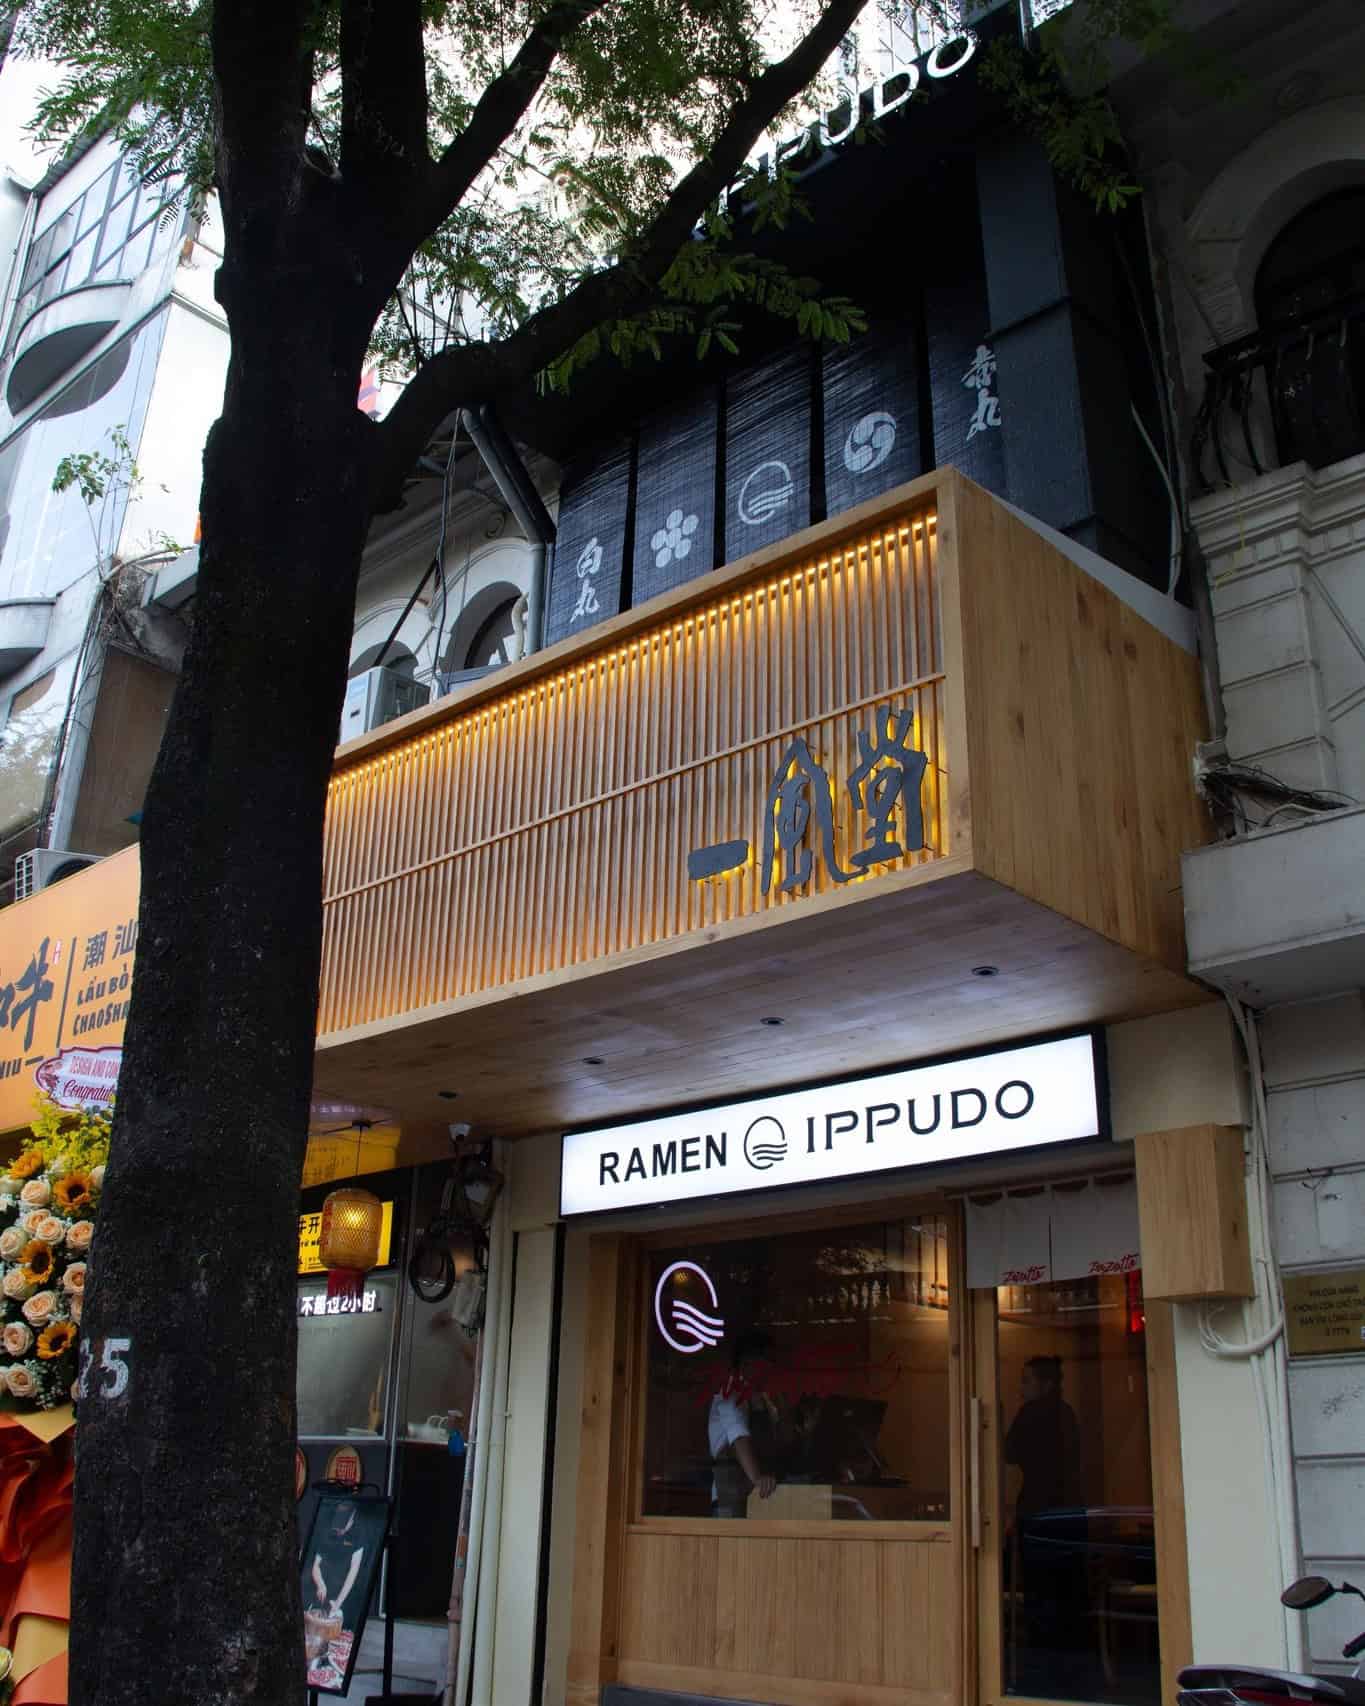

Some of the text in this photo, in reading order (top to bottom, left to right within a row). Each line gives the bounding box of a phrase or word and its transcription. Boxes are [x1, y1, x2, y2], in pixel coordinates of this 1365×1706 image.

[694, 30, 977, 240] PUDO
[600, 1080, 1034, 1186] RAMEN IPPUDO
